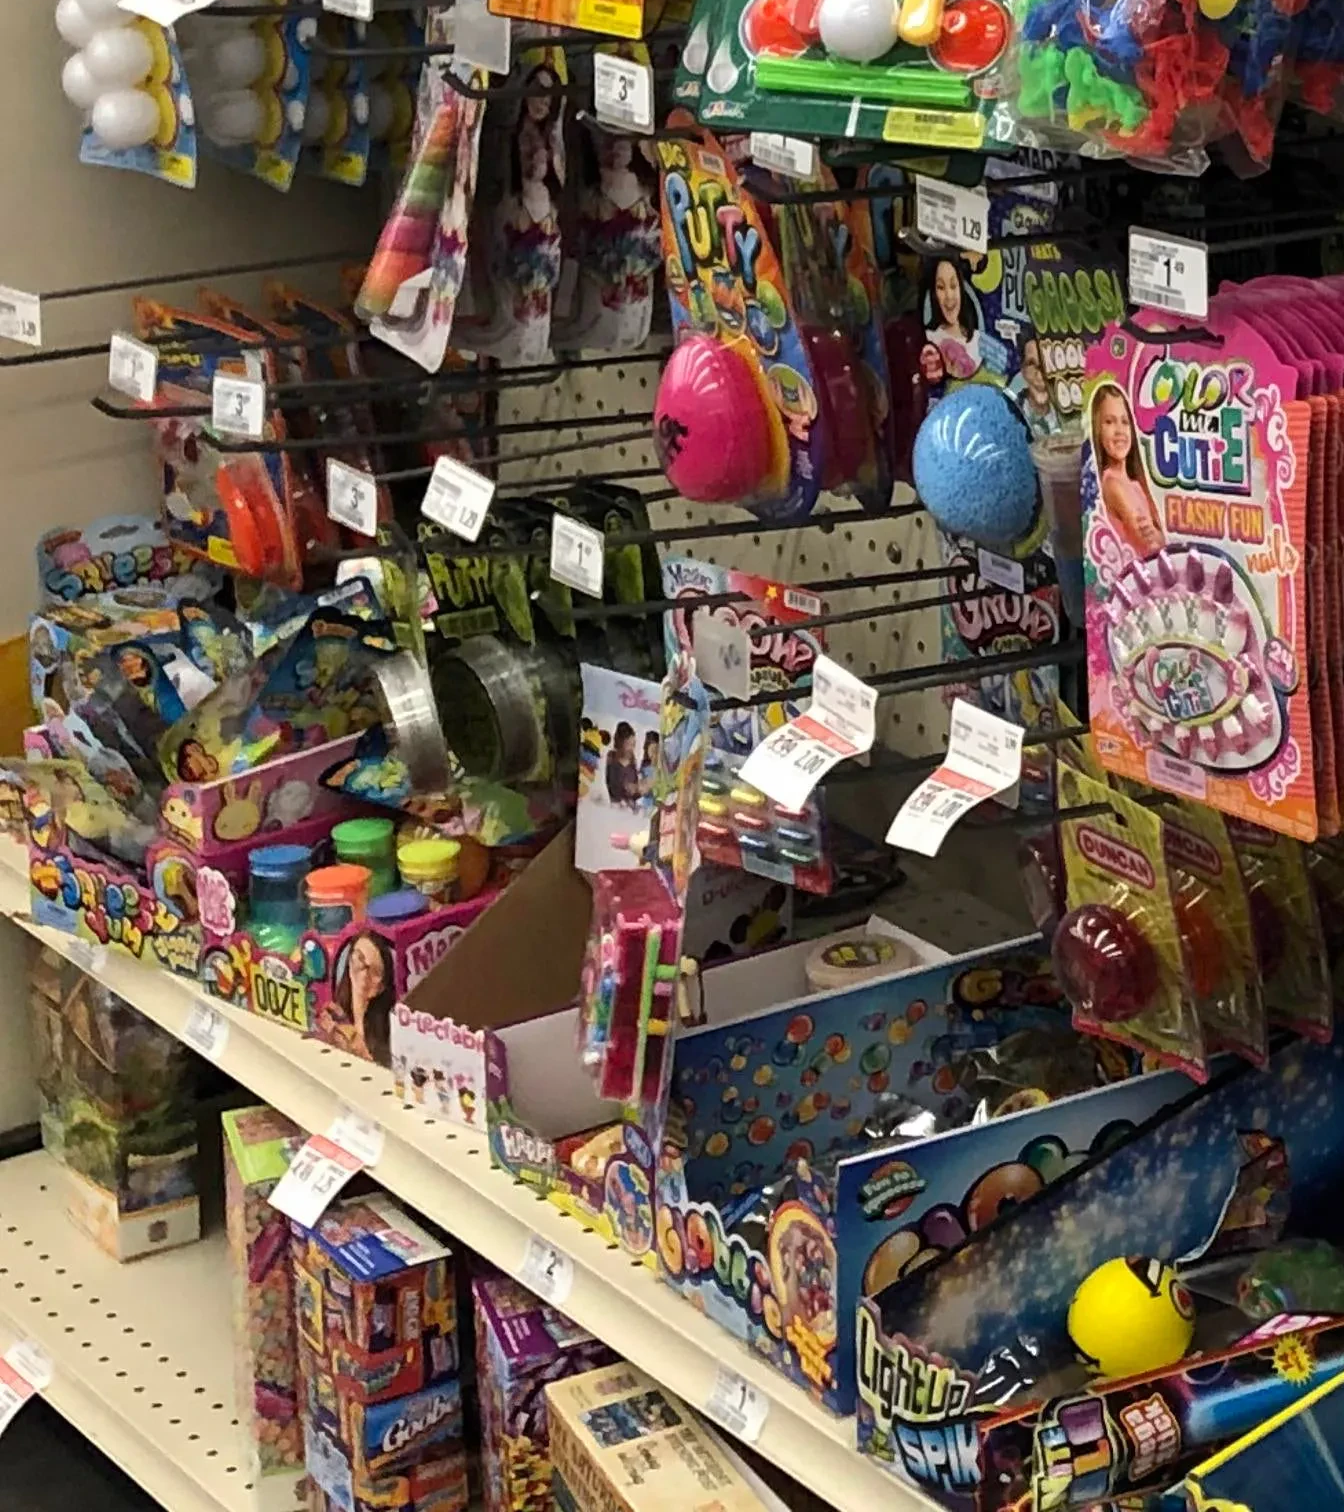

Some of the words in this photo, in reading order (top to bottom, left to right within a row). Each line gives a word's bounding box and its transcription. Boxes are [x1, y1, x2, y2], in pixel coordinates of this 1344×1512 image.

[1166, 500, 1226, 535] FLASHY
[1230, 507, 1263, 539] FUN
[1246, 527, 1299, 576] nails
[1083, 838, 1148, 881] DUNCAN
[254, 975, 303, 1024] OOZE
